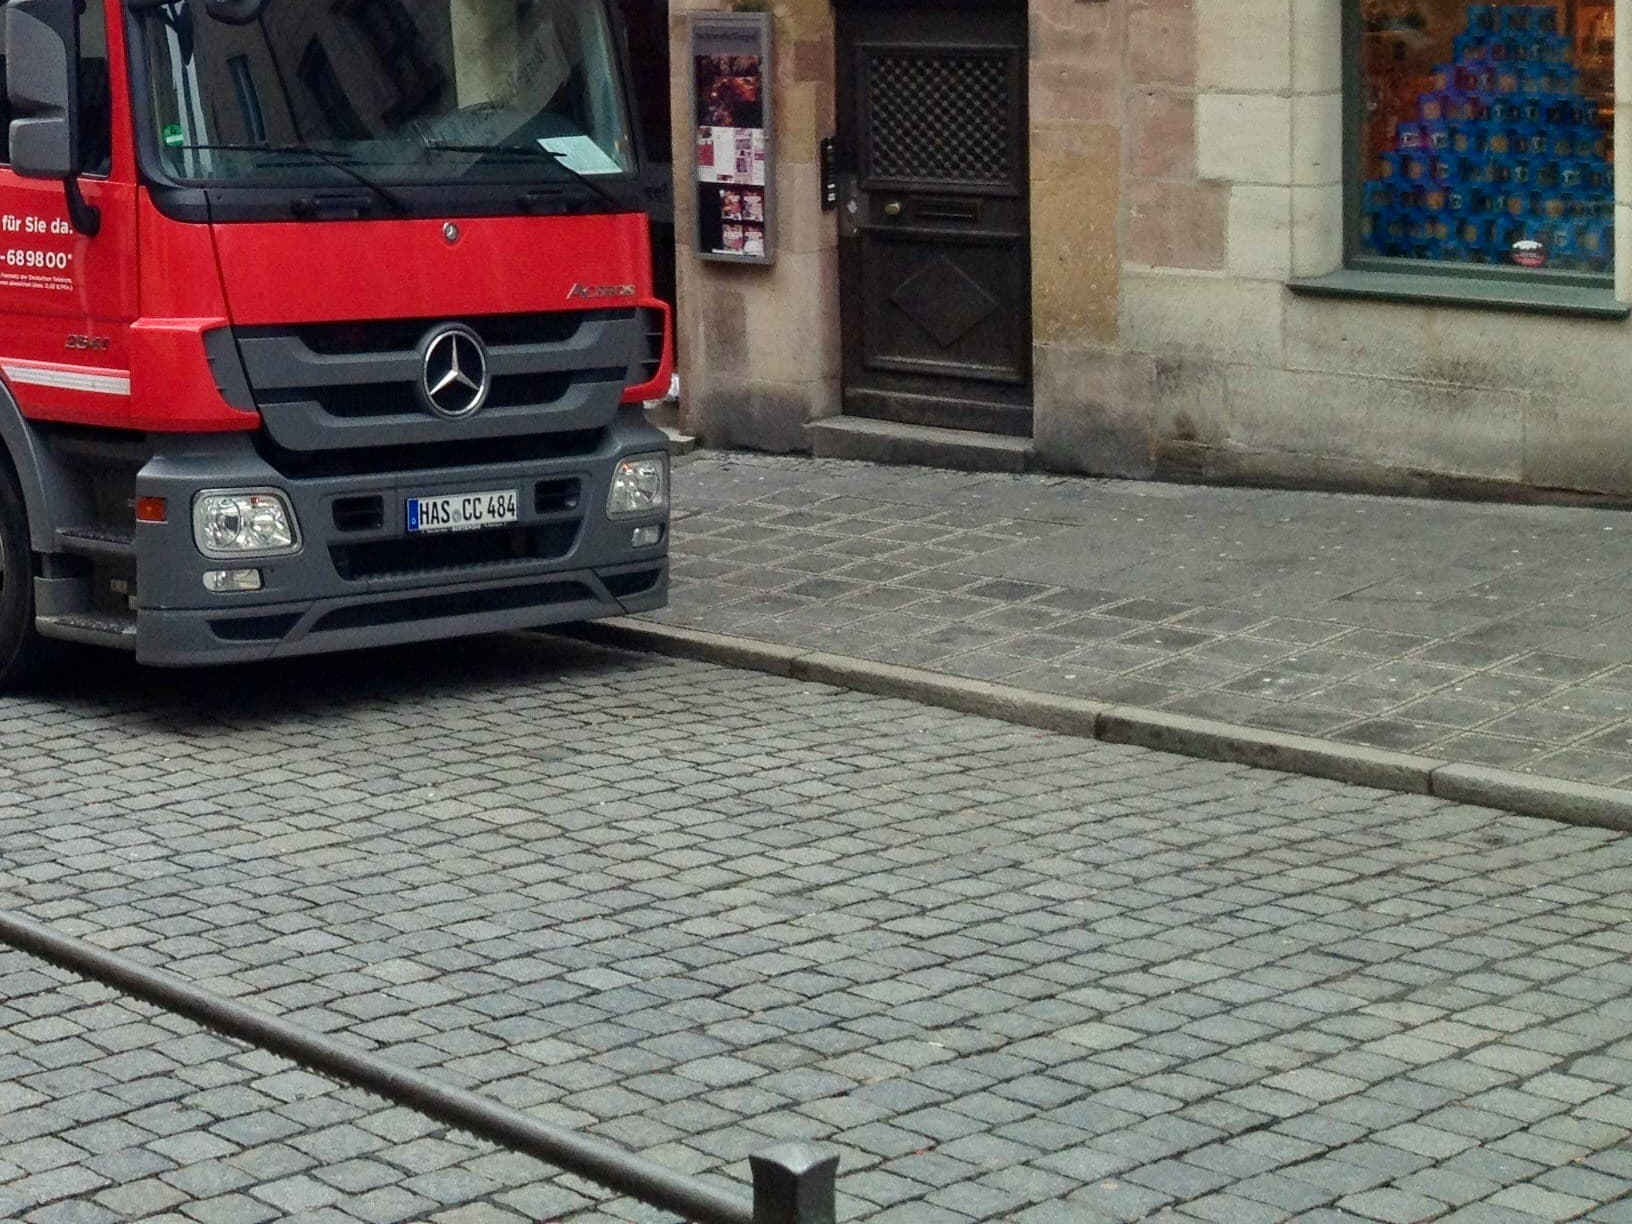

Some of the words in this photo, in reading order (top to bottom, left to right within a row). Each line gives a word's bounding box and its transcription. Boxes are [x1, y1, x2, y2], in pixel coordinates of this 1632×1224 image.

[2, 215, 21, 232] für
[25, 216, 47, 233] Sie
[50, 218, 73, 235] da.
[419, 500, 450, 526] HAS
[462, 497, 483, 521] CC
[487, 494, 516, 519] 484
